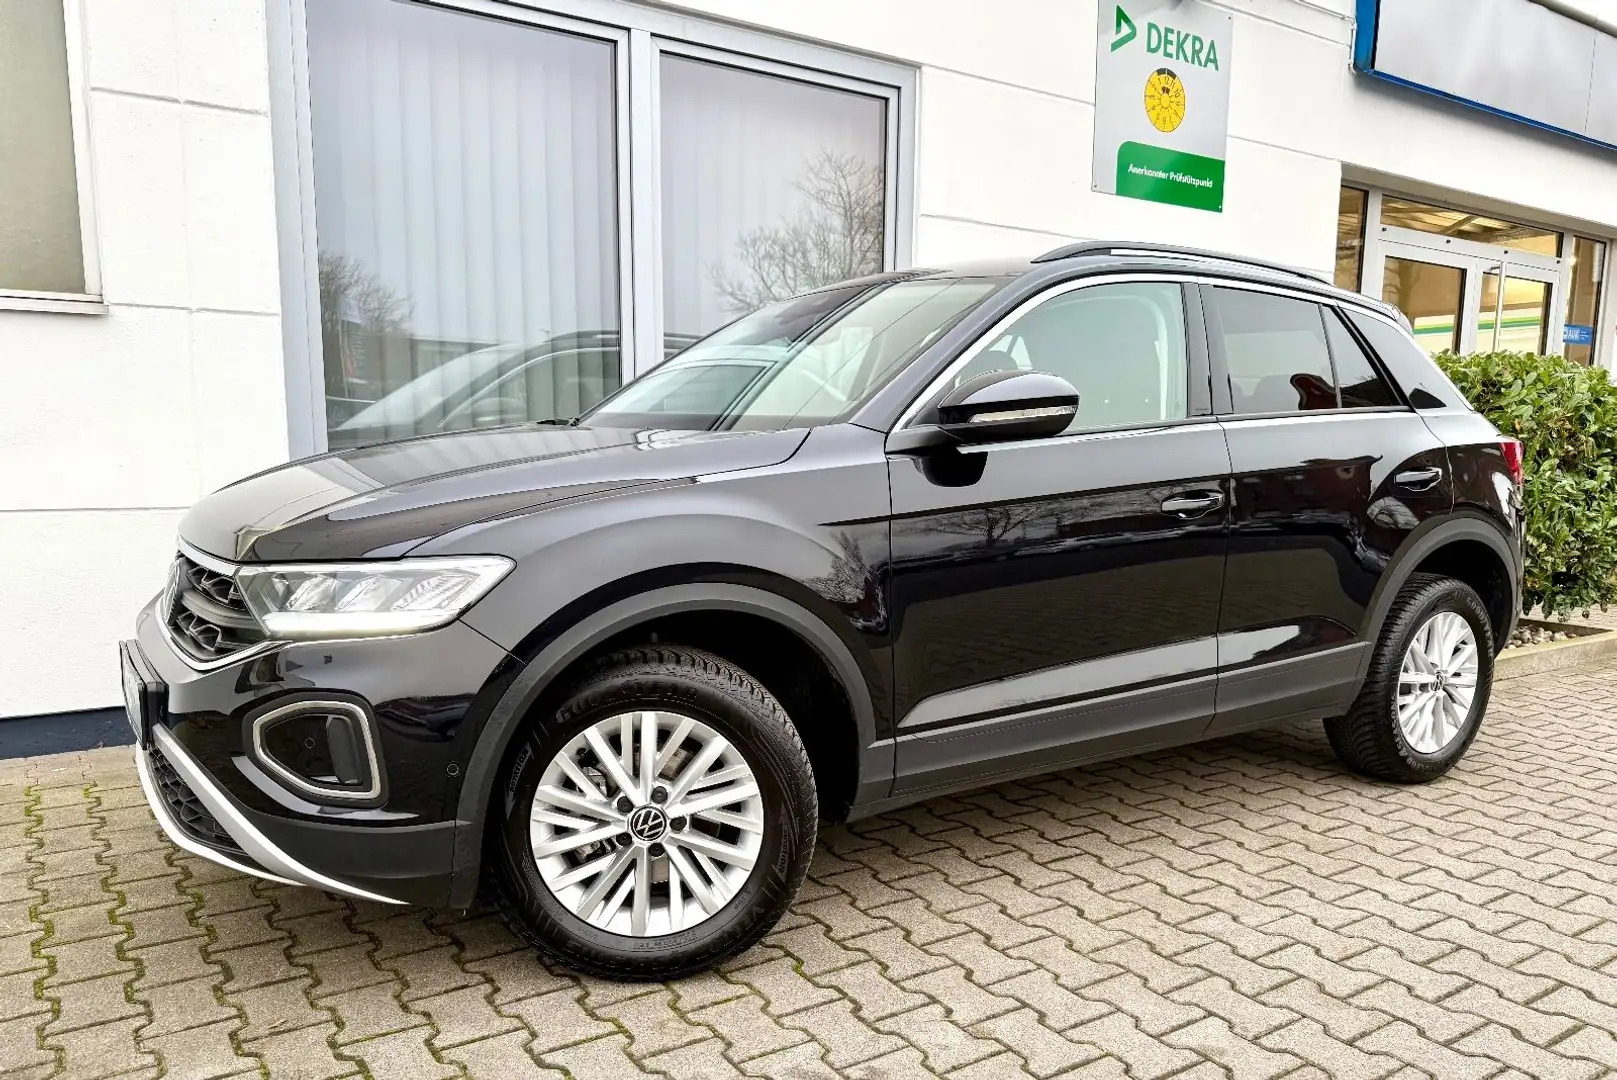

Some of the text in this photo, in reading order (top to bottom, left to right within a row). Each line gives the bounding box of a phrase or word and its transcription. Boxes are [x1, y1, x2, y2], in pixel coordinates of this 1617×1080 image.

[1146, 21, 1219, 71] DEKRA
[1127, 163, 1213, 188] Anerkannter Prüfstützpunkt
